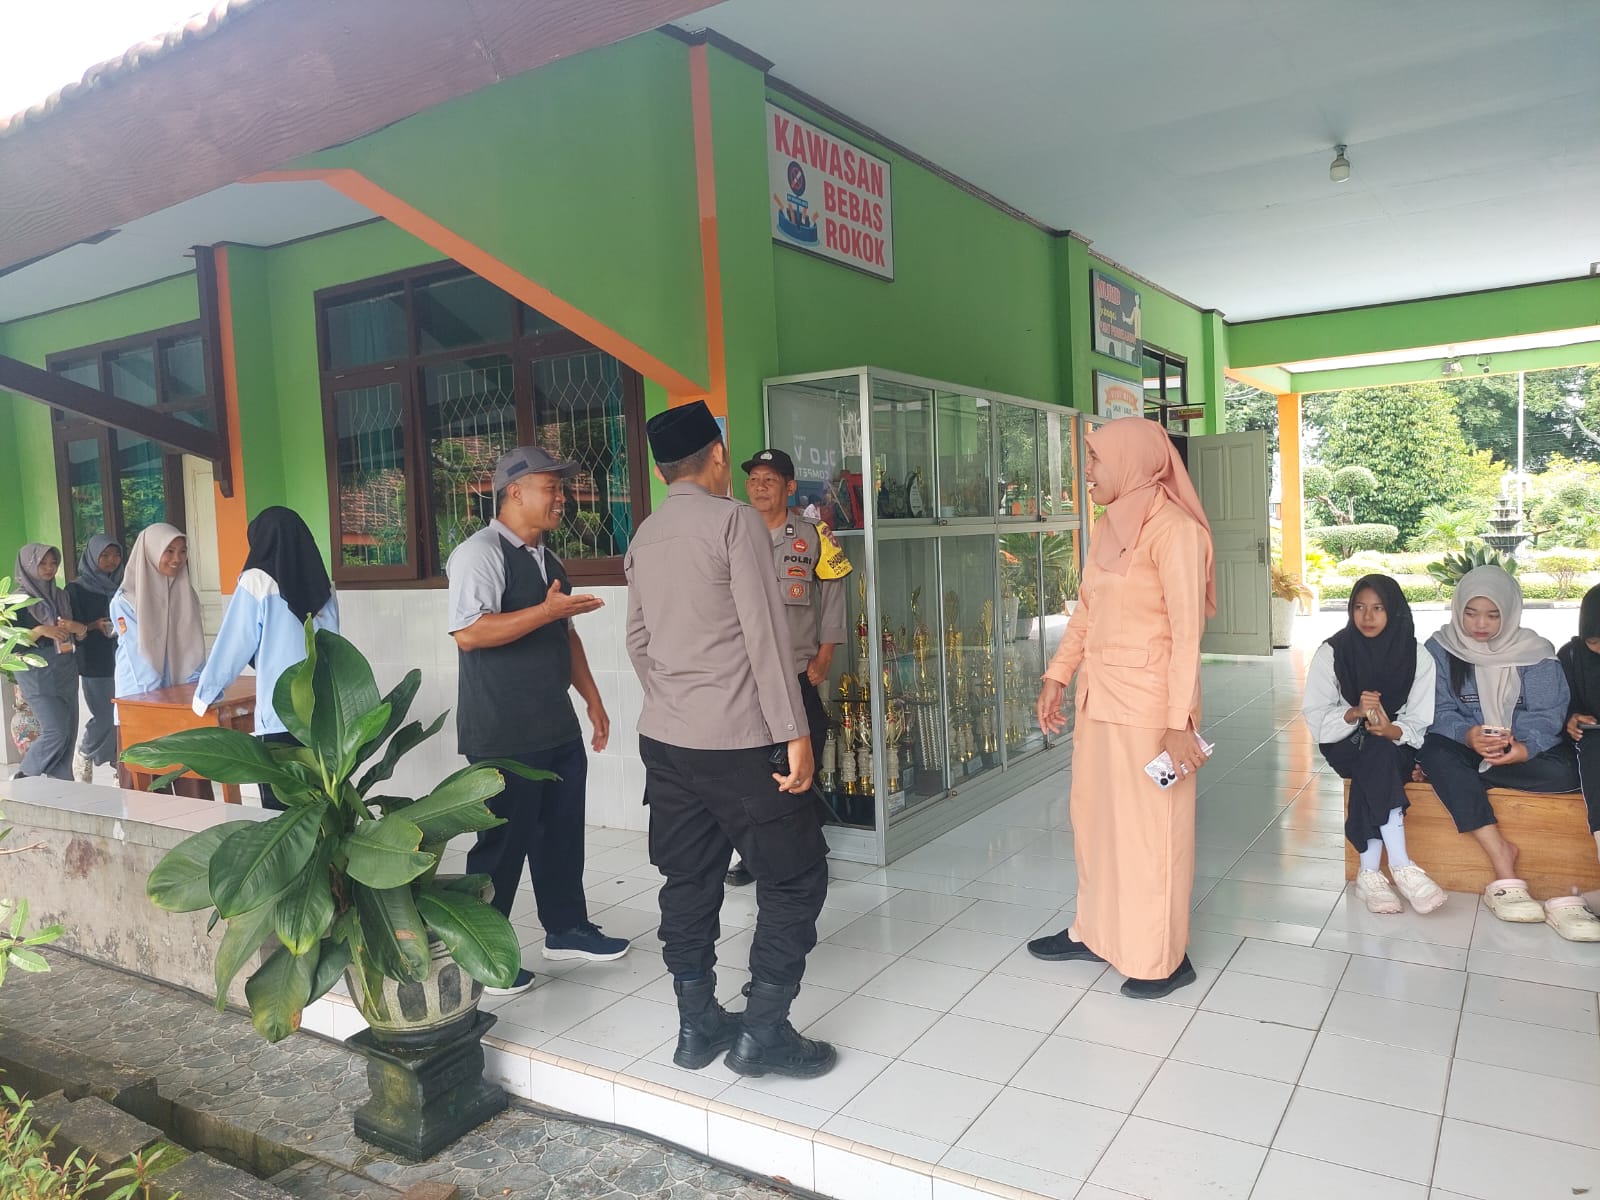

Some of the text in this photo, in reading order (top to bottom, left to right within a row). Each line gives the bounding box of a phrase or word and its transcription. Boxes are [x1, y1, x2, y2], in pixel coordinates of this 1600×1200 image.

[774, 113, 884, 199] KAWASAN
[823, 180, 884, 233] BEBAS
[825, 217, 886, 268] ROKOK
[784, 555, 812, 565] POLRI
